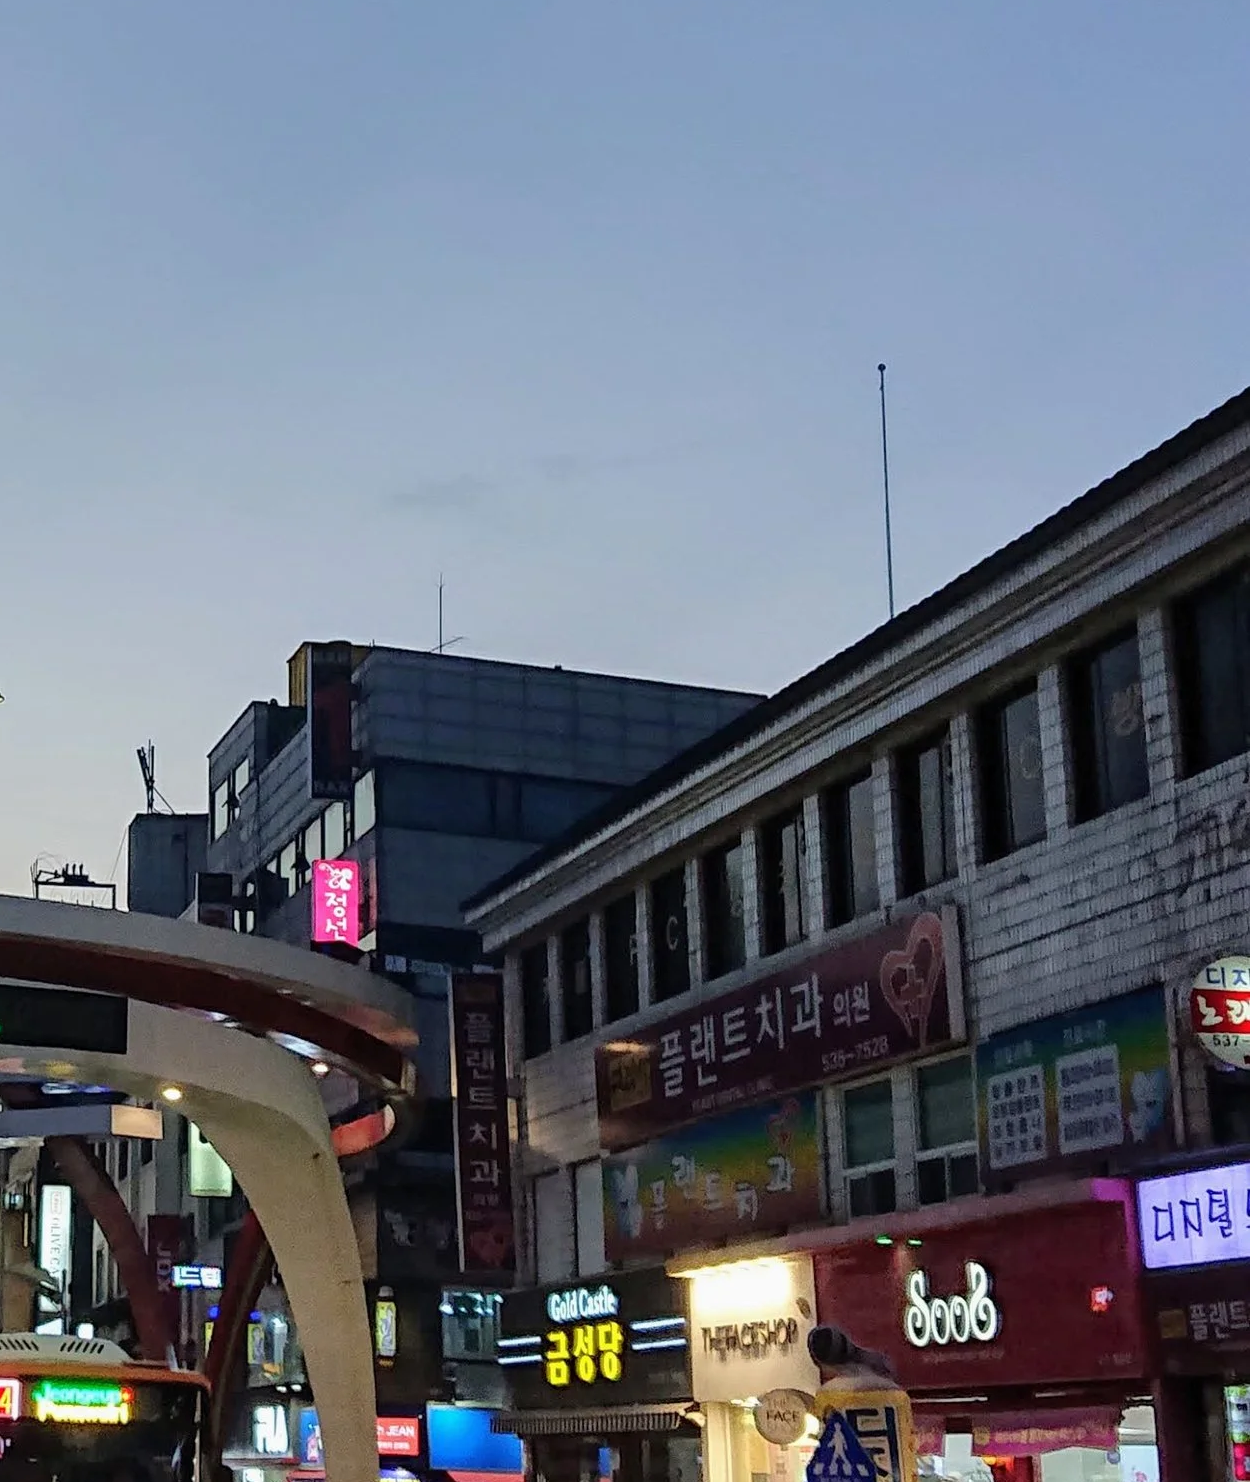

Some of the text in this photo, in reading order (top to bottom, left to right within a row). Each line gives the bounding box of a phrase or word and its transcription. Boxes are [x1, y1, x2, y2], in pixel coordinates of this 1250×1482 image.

[658, 971, 824, 1098] 플랜트치과
[832, 981, 871, 1026] 의원
[1152, 1188, 1233, 1242] 디지털
[549, 1284, 621, 1322] Gold Castle
[546, 1321, 625, 1387] 금성당
[386, 1425, 414, 1437] JEAN
